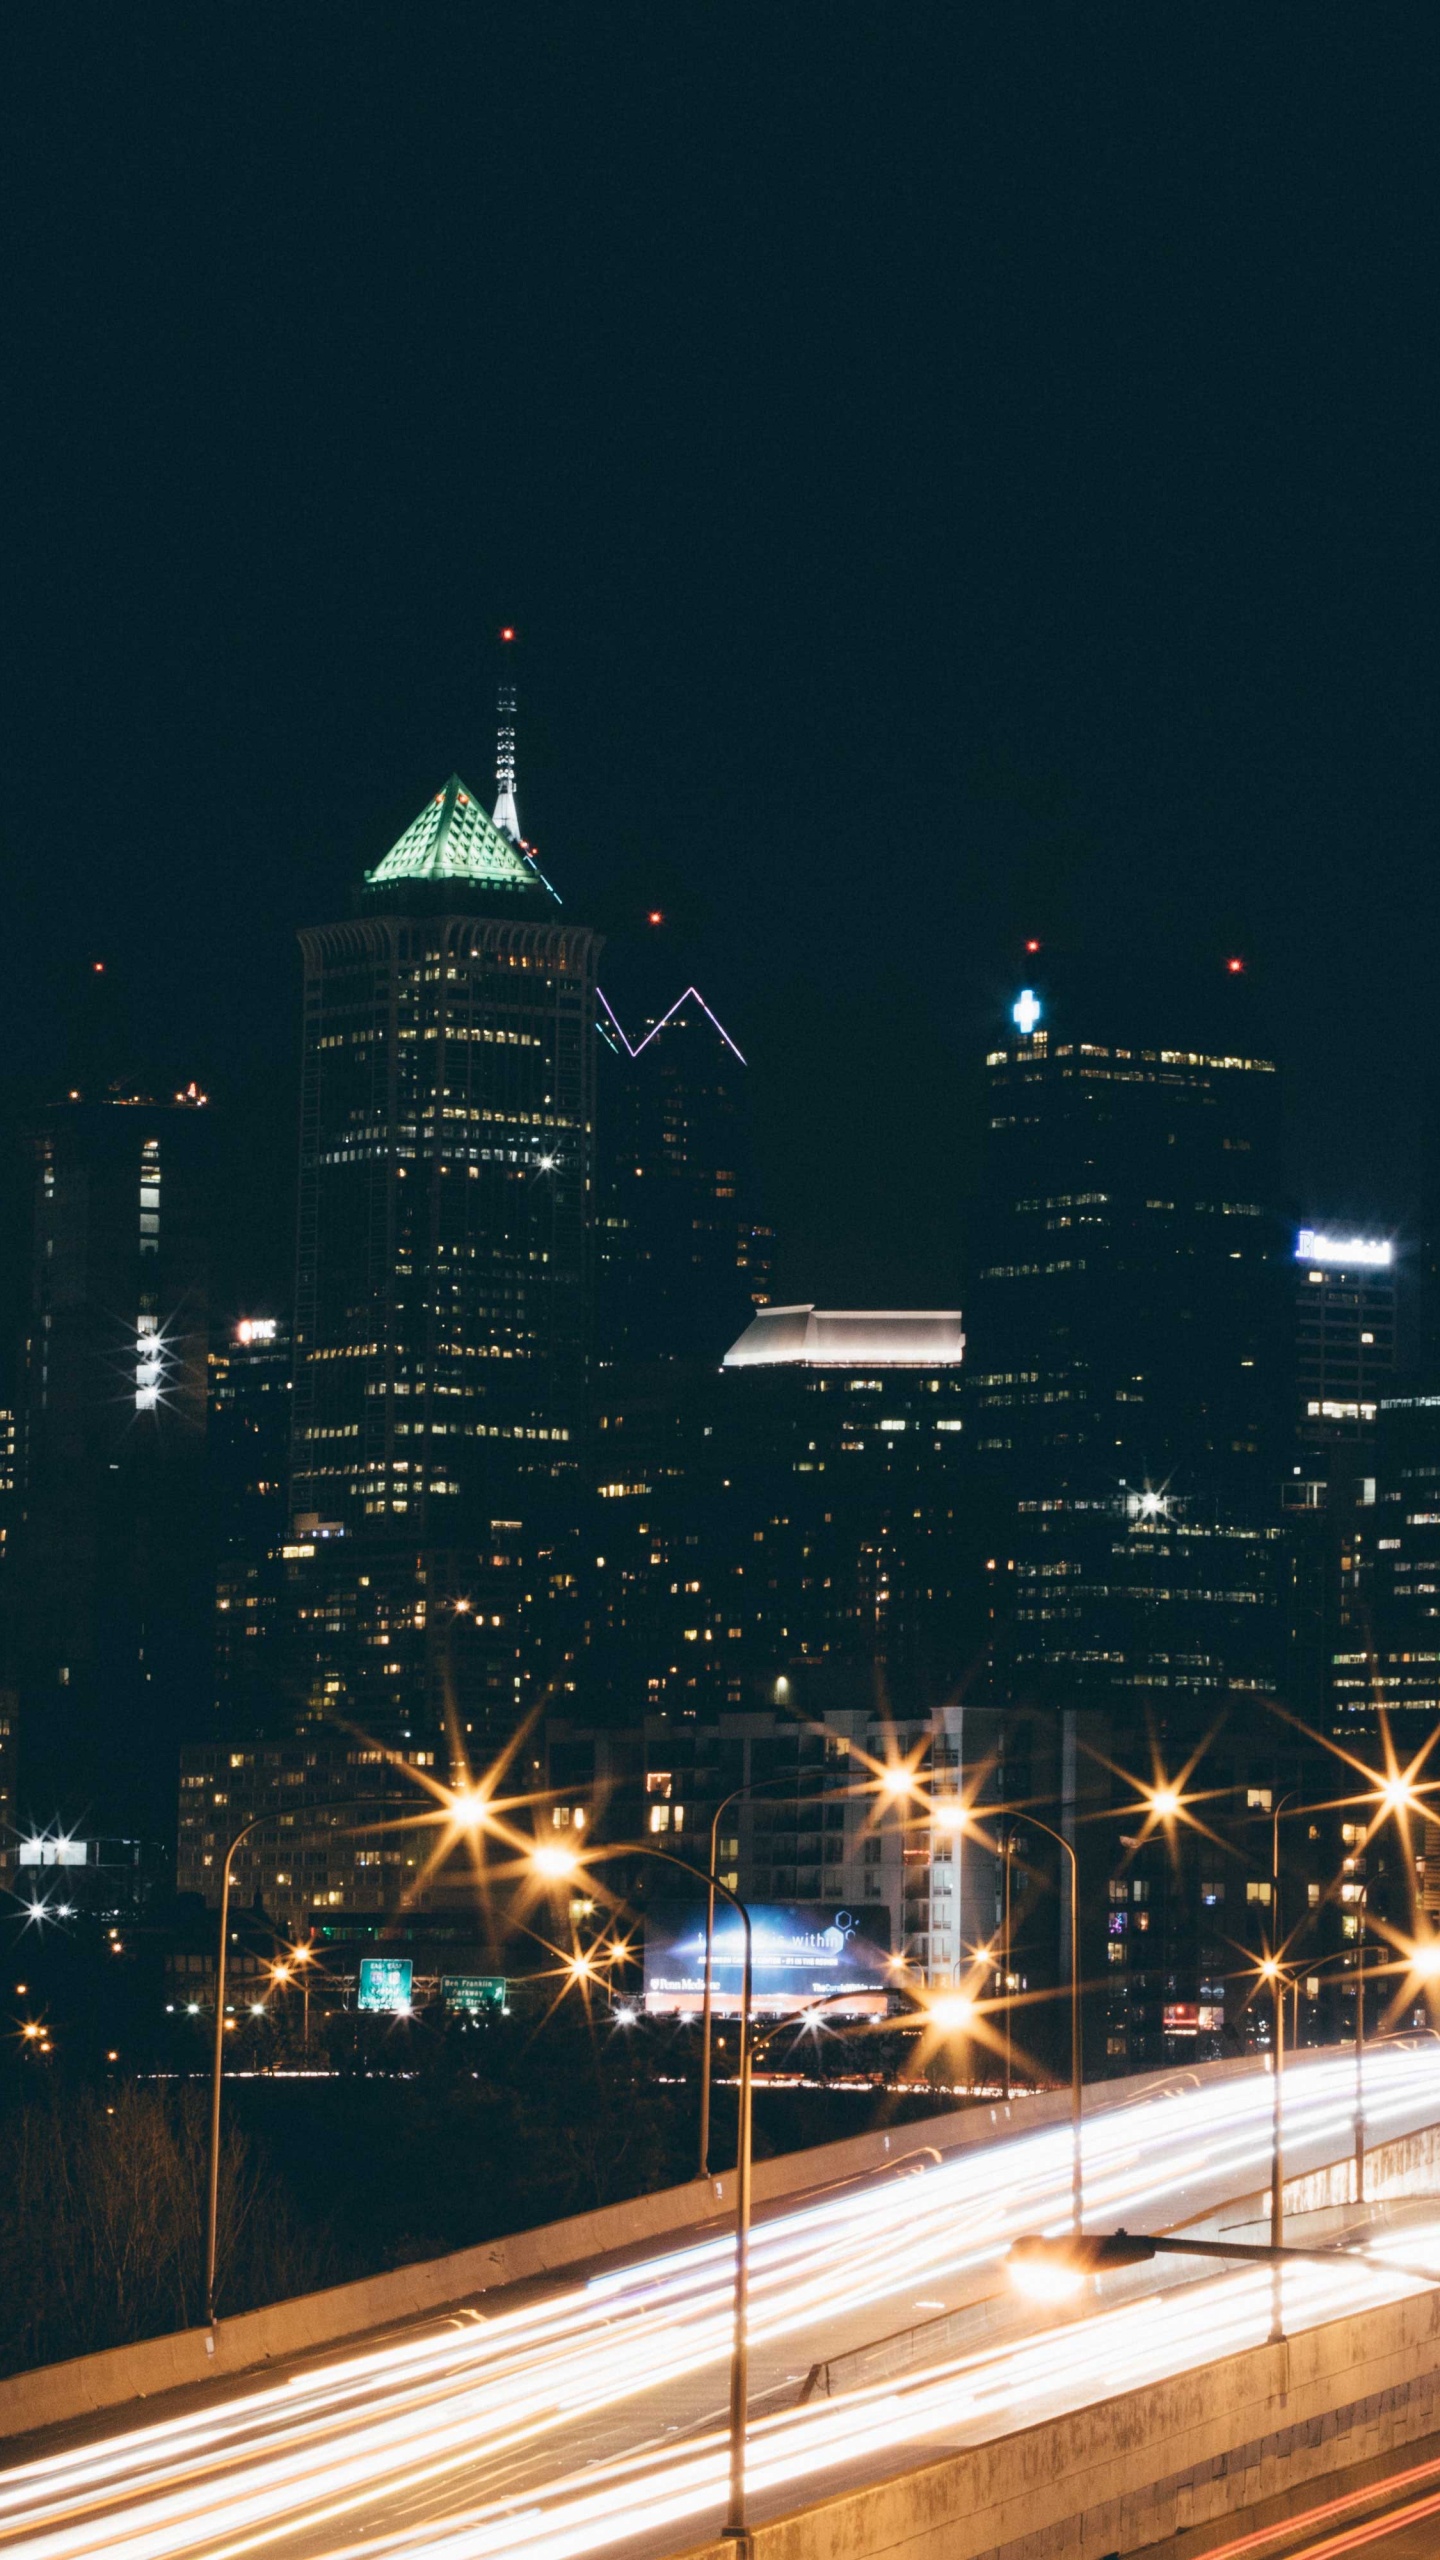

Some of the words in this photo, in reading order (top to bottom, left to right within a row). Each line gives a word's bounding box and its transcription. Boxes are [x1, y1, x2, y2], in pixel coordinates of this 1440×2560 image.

[251, 1319, 276, 1339] PNC
[792, 1932, 838, 1948] within
[462, 1980, 492, 1988] Franklin
[660, 1978, 681, 1990] Penn
[681, 1978, 720, 1991] Medine
